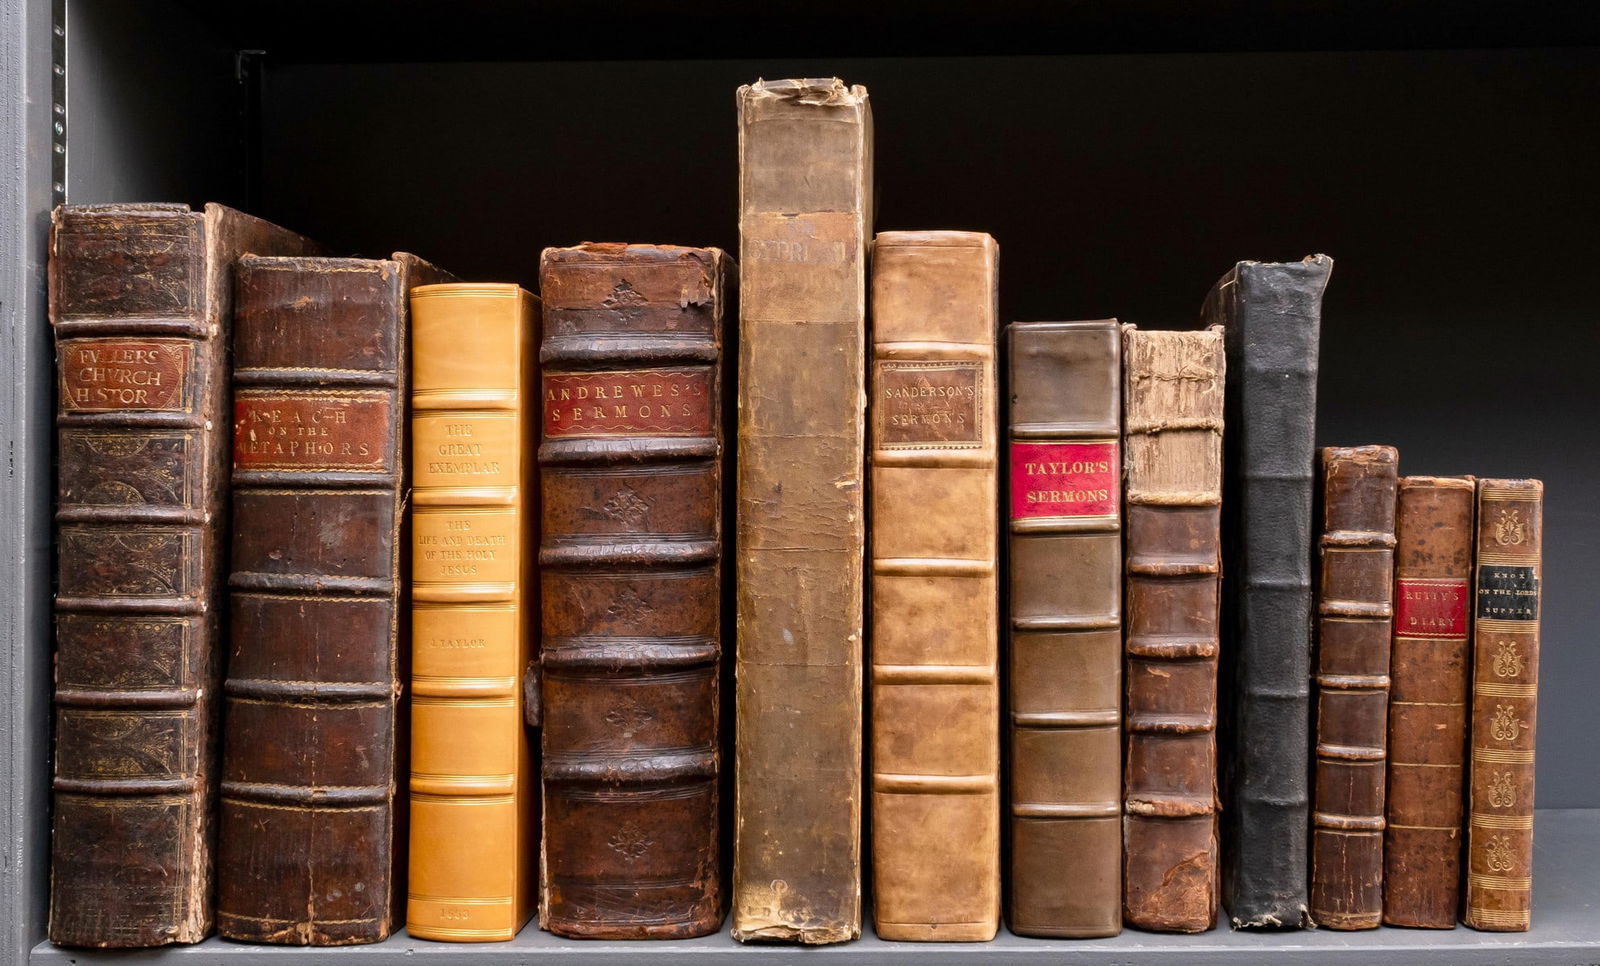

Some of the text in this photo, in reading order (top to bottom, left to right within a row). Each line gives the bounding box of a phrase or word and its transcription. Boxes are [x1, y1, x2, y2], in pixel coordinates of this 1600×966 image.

[80, 367, 160, 386] CHVRCH
[548, 383, 701, 401] ANDREWES'S
[886, 386, 975, 399] SANDERSON'S
[552, 404, 692, 422] SERMONS
[892, 412, 965, 426] SERMONS
[268, 426, 329, 436] ON THE
[447, 424, 473, 436] THE
[438, 443, 481, 456] GREAT
[428, 461, 501, 475] EXEMPLAR
[1025, 461, 1109, 475] TAYLOR'S
[1027, 489, 1108, 503] SERMONS
[446, 520, 471, 531] THE
[417, 535, 505, 546] LIFE AND DEATH
[425, 550, 496, 561] OF THE HOLY
[440, 565, 477, 576] JESUS
[1492, 588, 1511, 596] THE
[1485, 606, 1532, 615] SUPPER
[1410, 616, 1455, 627] DIARY
[440, 639, 485, 649] TAYLOR
